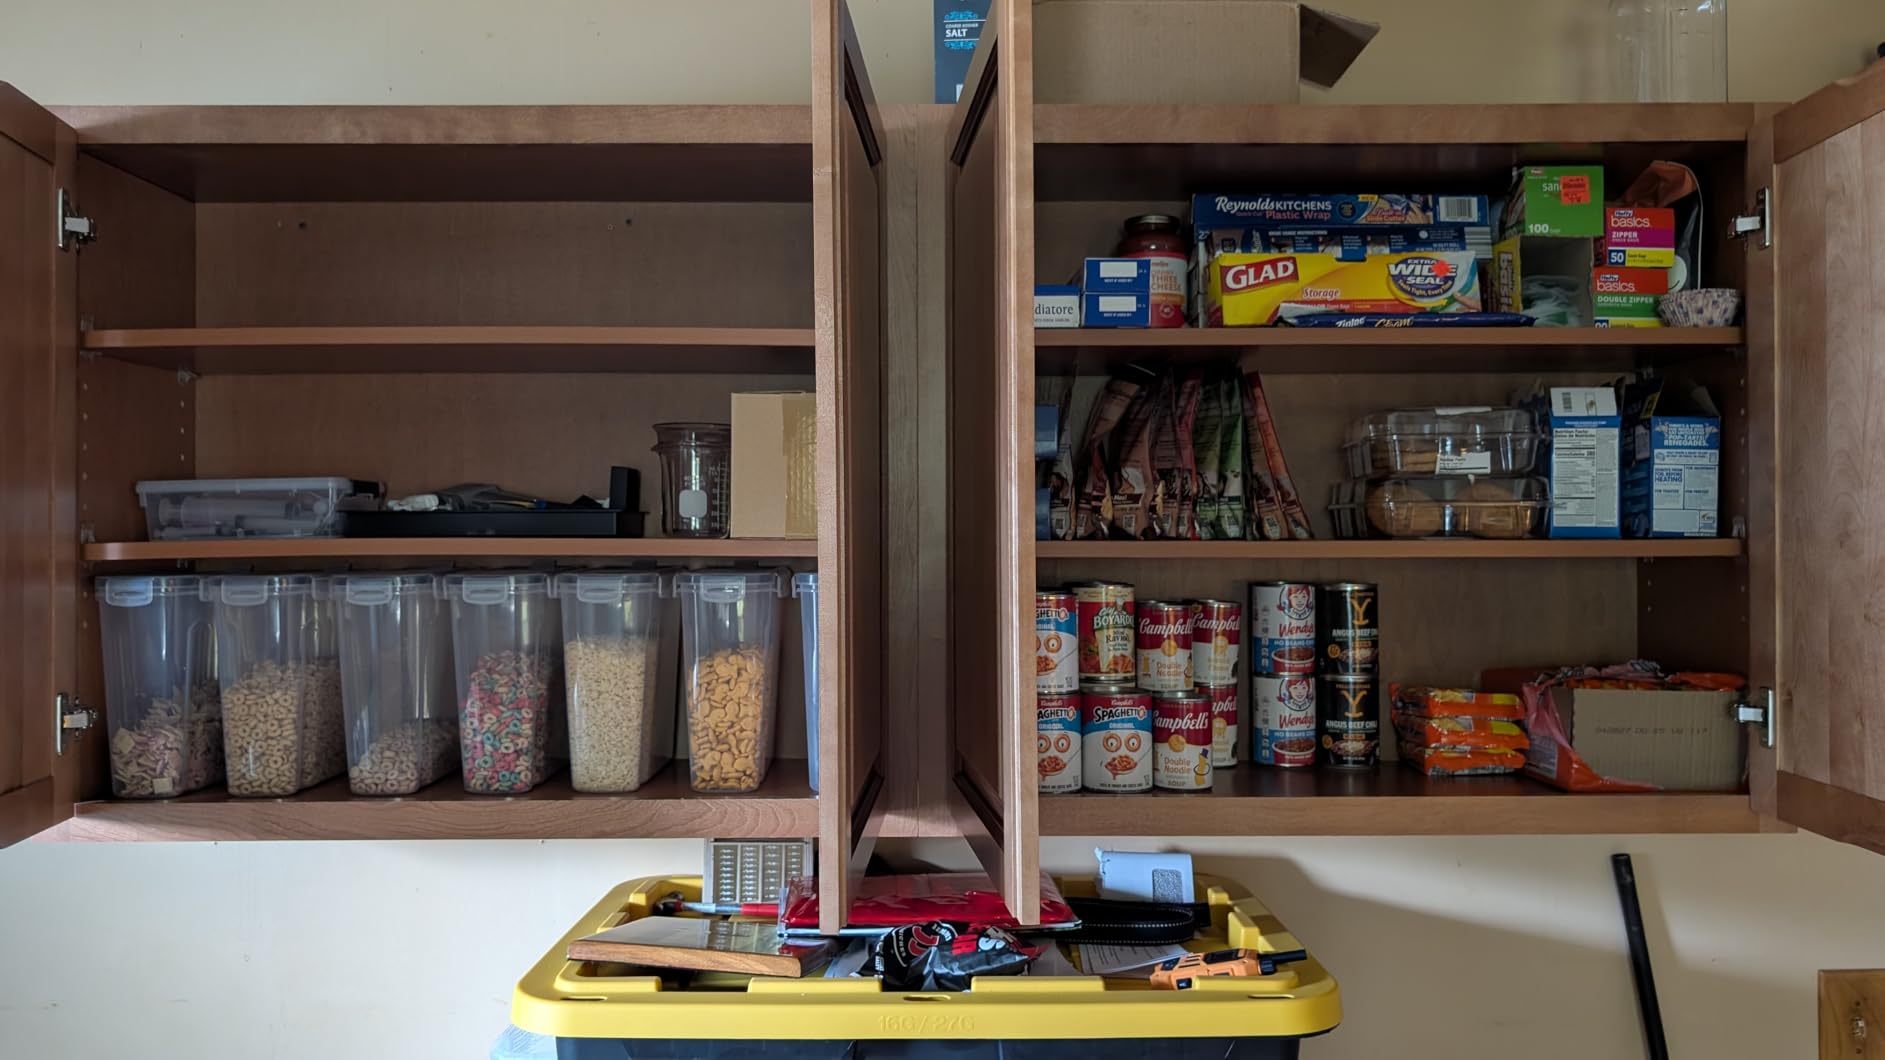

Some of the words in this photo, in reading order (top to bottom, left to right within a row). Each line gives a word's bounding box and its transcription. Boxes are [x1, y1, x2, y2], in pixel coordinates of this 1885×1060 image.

[946, 29, 968, 37] SALT
[1543, 182, 1562, 191] san
[1215, 196, 1275, 214] Reynolds
[1275, 201, 1332, 211] KITCHENS
[1265, 210, 1300, 220] Plastic
[1303, 211, 1332, 221] Wrap
[1611, 216, 1650, 228] basics
[1528, 224, 1549, 233] 100
[1610, 252, 1624, 263] 50
[1225, 259, 1295, 290] GLAD
[1406, 277, 1445, 285] SEAL
[1597, 280, 1635, 292] basics
[1303, 288, 1339, 301] Storage
[1629, 296, 1654, 304] ZIPPER
[1034, 303, 1074, 315] diatore
[1331, 628, 1355, 637] ANGUS
[1355, 628, 1370, 637] BEEF
[1325, 719, 1348, 728] ANGUS
[1348, 720, 1365, 729] BEEF
[1164, 757, 1191, 765] Double
[1164, 765, 1191, 774] Noodle
